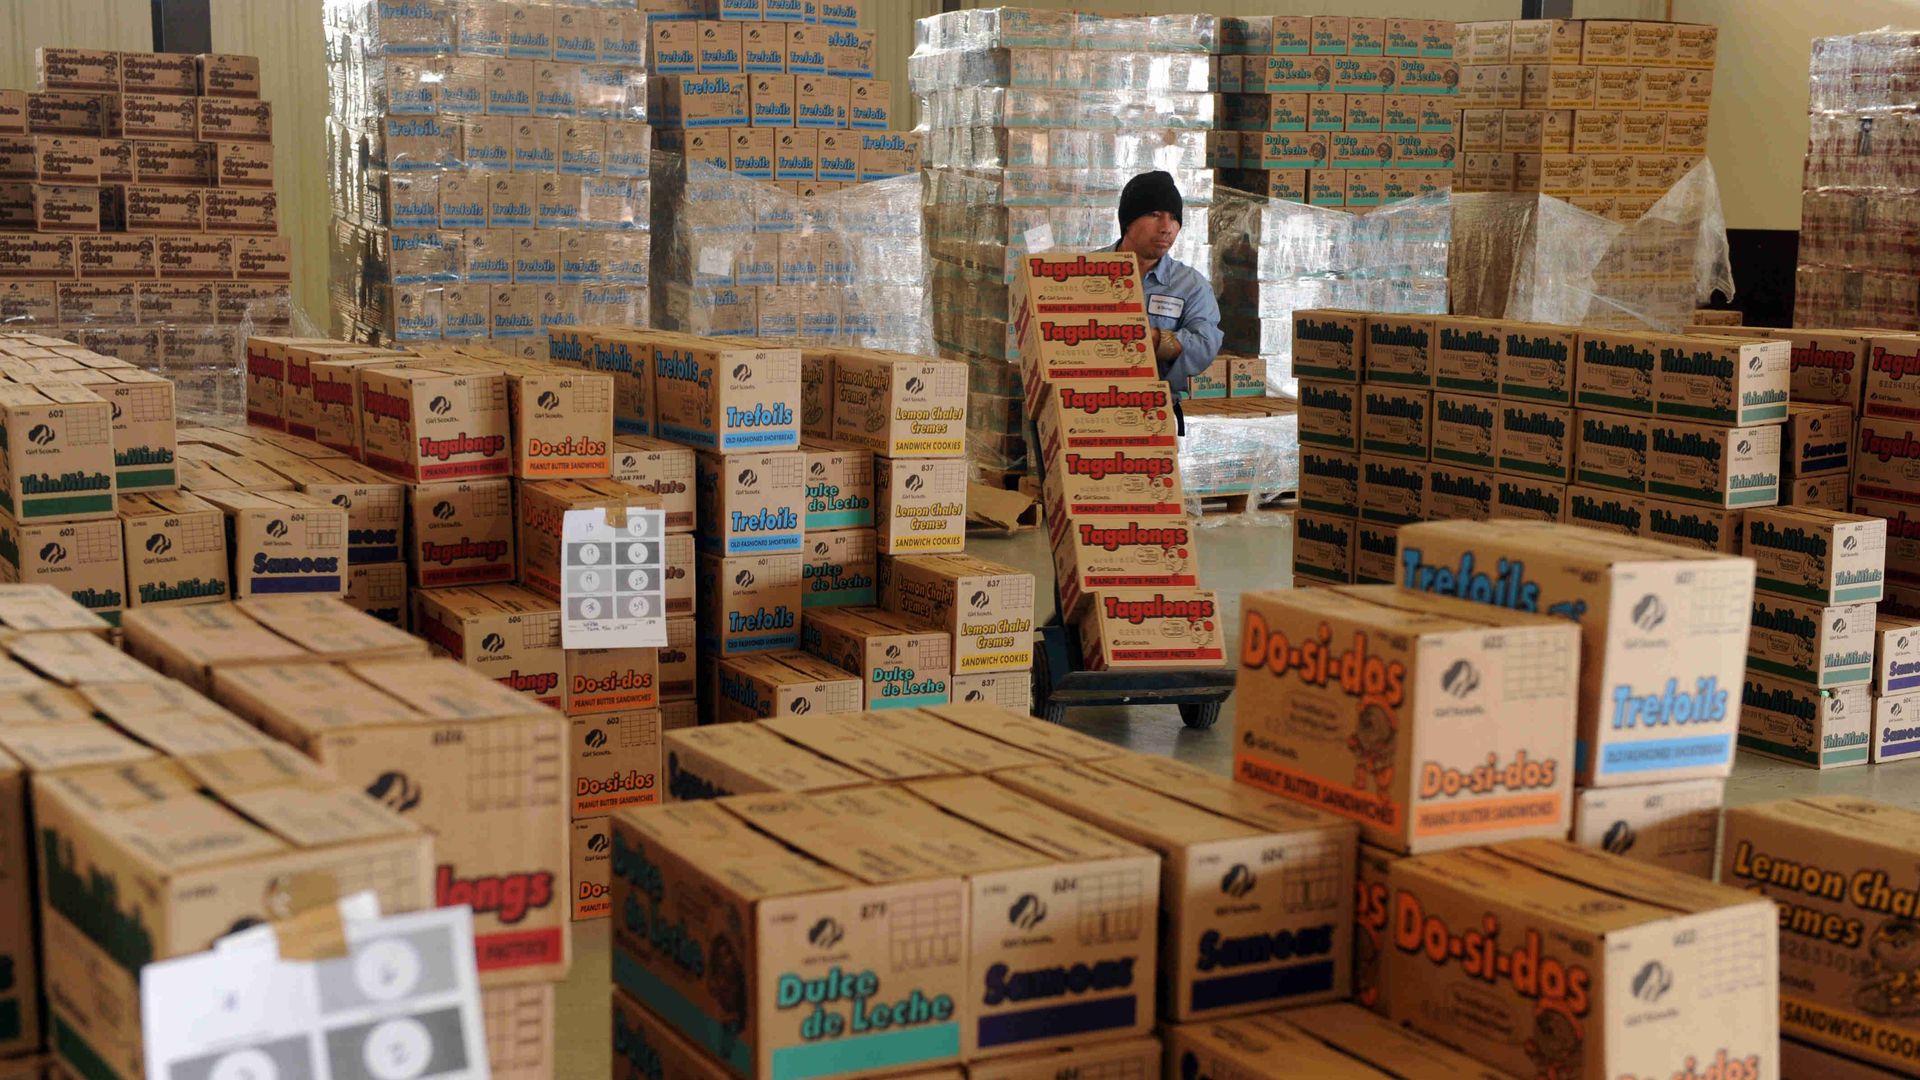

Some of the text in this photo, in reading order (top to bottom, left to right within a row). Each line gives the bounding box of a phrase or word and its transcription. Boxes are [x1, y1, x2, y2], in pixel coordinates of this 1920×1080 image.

[827, 32, 859, 48] efoils
[684, 78, 730, 95] Trefoils
[1030, 257, 1134, 282] Tagalongs
[1041, 320, 1146, 346] Tagalongs
[595, 343, 632, 373] Trefoils
[656, 351, 699, 382] Trefoils
[1792, 341, 1854, 373] galongs
[921, 367, 935, 375] 837
[454, 379, 467, 387] 606
[1060, 386, 1167, 414] Tagalongs
[48, 410, 64, 418] 602
[726, 402, 793, 428] Trefoils
[895, 406, 963, 421] Lemon Chalet
[911, 420, 948, 435] Cremes
[420, 432, 504, 460] Tagalongs
[528, 435, 606, 458] Do-si-dos
[895, 441, 961, 451] SANDWICH COOKIES
[1862, 428, 1920, 462] Tagalo
[530, 461, 605, 470] PEANUT BUTTER SANDWICHES
[761, 458, 772, 466] 601
[1066, 452, 1173, 480] Tagalongs
[808, 496, 869, 512] de Leche
[895, 502, 962, 518] Lemon Chalet
[164, 519, 179, 528] 602
[291, 514, 305, 522] 604
[731, 507, 798, 532] Trefoils
[910, 517, 947, 531] Cremes
[895, 536, 961, 547] SANDWICH COOKIES
[1080, 522, 1188, 550] Tagalongs
[422, 537, 508, 565] Tagalongs
[252, 552, 339, 574] Samoas
[802, 562, 843, 579] Dulce
[812, 574, 872, 591] de Leche
[987, 579, 1000, 587] 837
[1401, 549, 1540, 614] Trefoils
[508, 616, 522, 624] 606
[729, 605, 794, 633] Trefoils
[1104, 594, 1214, 624] Tagalongs
[961, 618, 1030, 637] Lemon Chalet
[907, 640, 919, 648] 879
[976, 635, 1015, 650] Cremes
[962, 653, 1029, 667] SANDWICH COOKIES
[1242, 609, 1408, 708] Do-si-dos
[573, 669, 652, 694] Do-si-dos
[872, 667, 915, 683] Dulce
[882, 679, 945, 697] de Leche
[575, 693, 652, 708] PEANUT BUTTER SANDWICHES
[1612, 676, 1729, 729] Trefoils
[577, 770, 654, 796] Do-si-dos
[1420, 750, 1556, 799] Do-si-dos
[1734, 841, 1845, 901] Lemon
[436, 864, 554, 923] longs
[1396, 889, 1591, 1019] Do-si-dos
[777, 965, 879, 1010] Dulce
[983, 955, 1137, 1006] Samoas
[800, 990, 954, 1040] de Leche
[1783, 1001, 1873, 1045] SANDWICH
